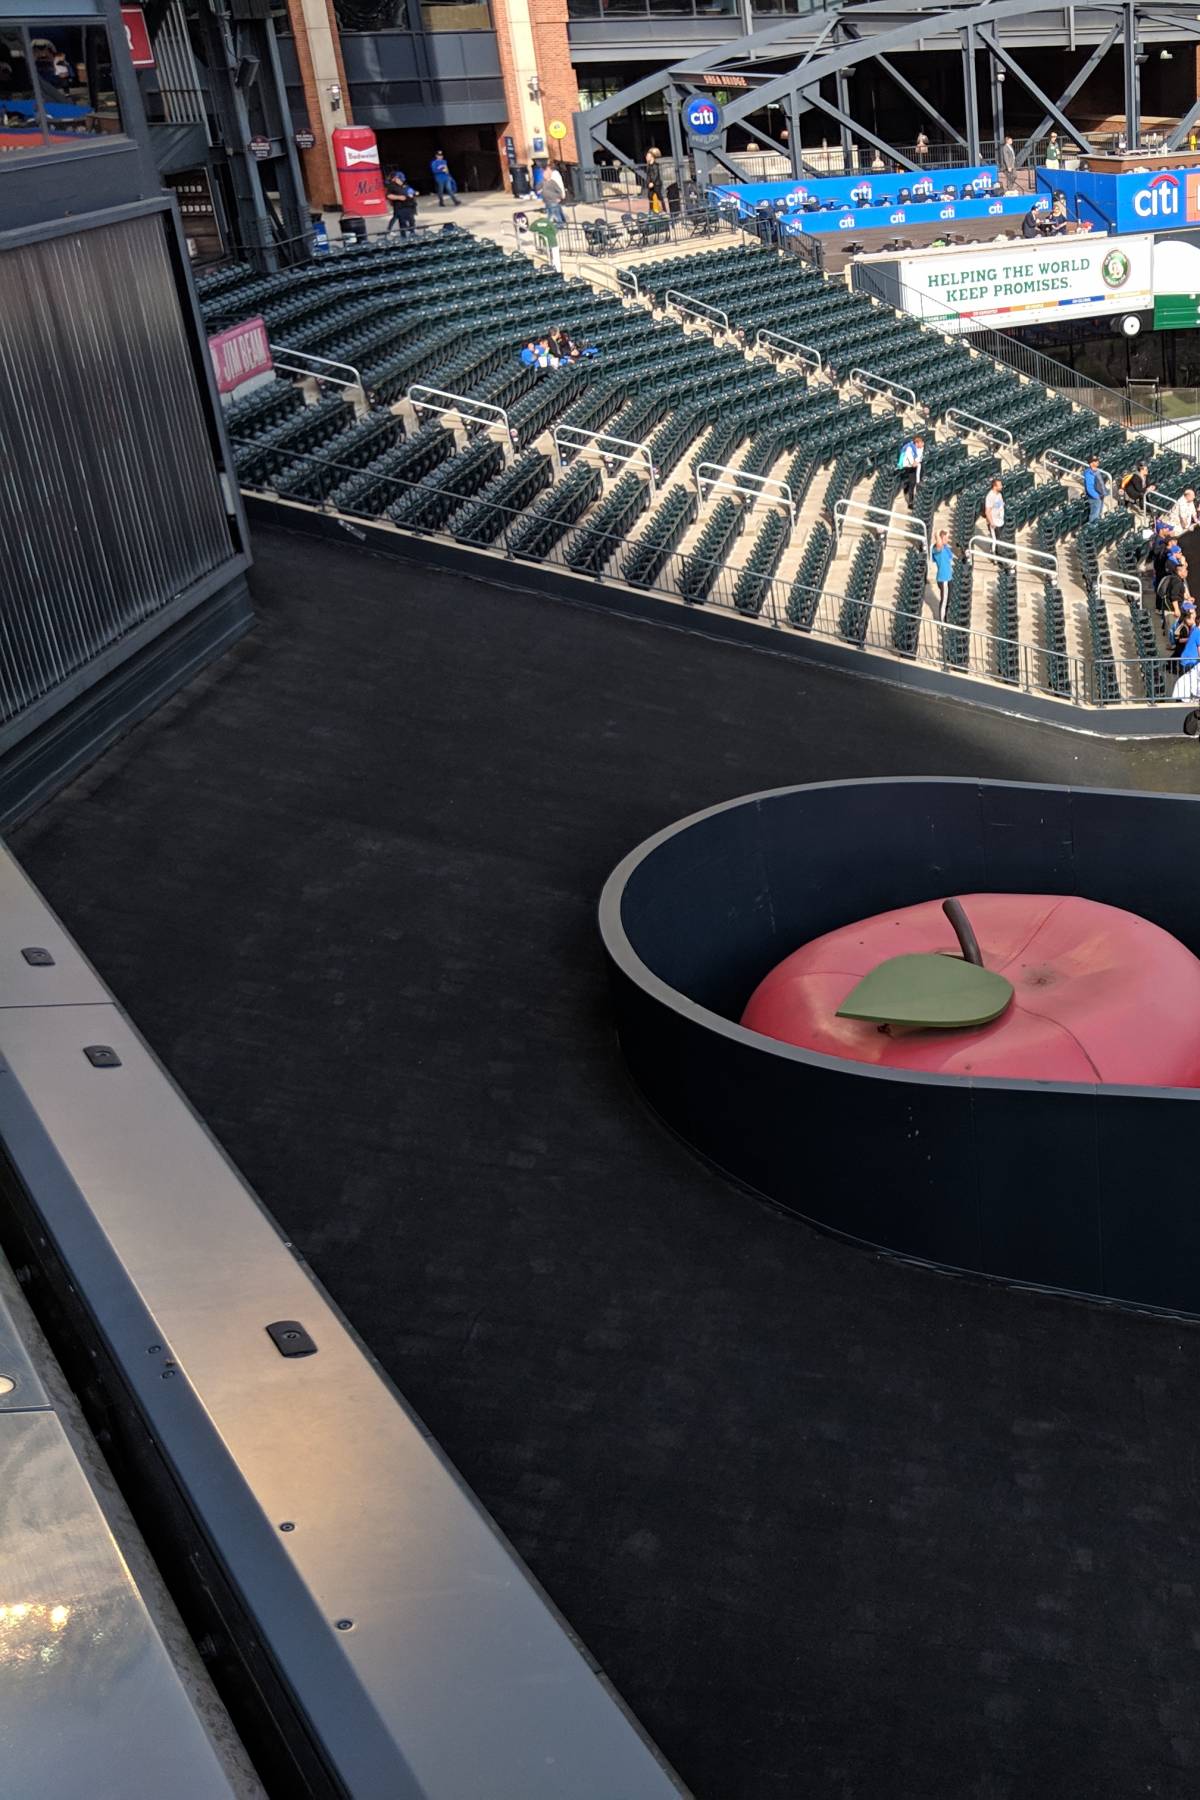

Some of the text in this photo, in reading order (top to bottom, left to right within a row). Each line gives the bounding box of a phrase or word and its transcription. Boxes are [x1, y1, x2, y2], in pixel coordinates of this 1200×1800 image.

[690, 109, 714, 126] citi
[1134, 181, 1178, 217] citi
[927, 268, 998, 288] HELPING
[1003, 264, 1034, 279] THE
[1038, 258, 1090, 274] WORLD
[946, 276, 1073, 303] KEEP PROMISES.
[223, 327, 267, 381] JIM BEAM
